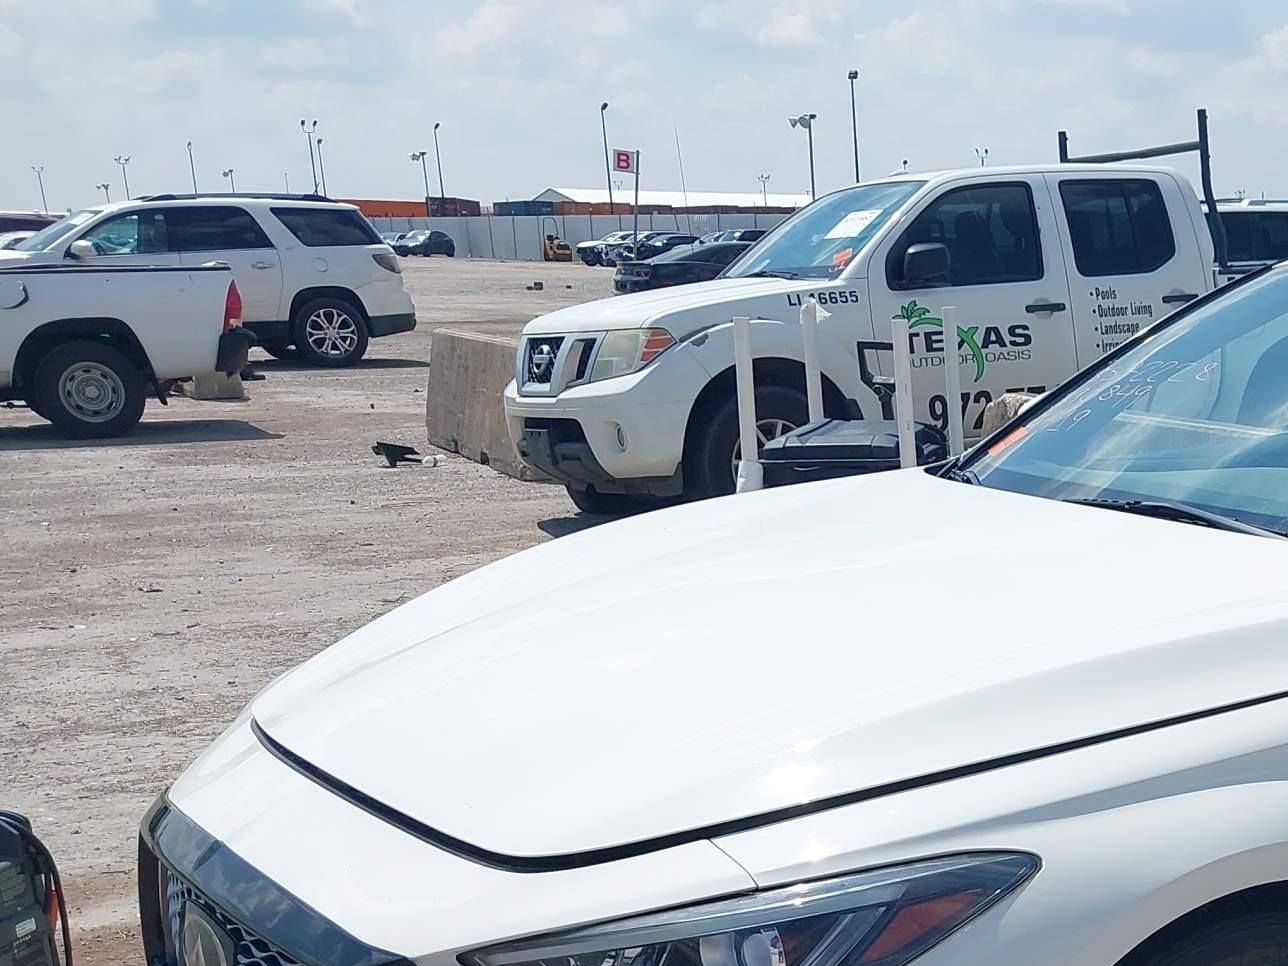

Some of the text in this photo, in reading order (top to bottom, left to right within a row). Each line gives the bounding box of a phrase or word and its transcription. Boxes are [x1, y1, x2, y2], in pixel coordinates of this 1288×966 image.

[616, 152, 630, 170] B
[1095, 286, 1117, 300] Pools
[1097, 301, 1152, 318] Outdoor Living
[1099, 320, 1140, 336] Landscape
[985, 349, 1032, 363] OASIS
